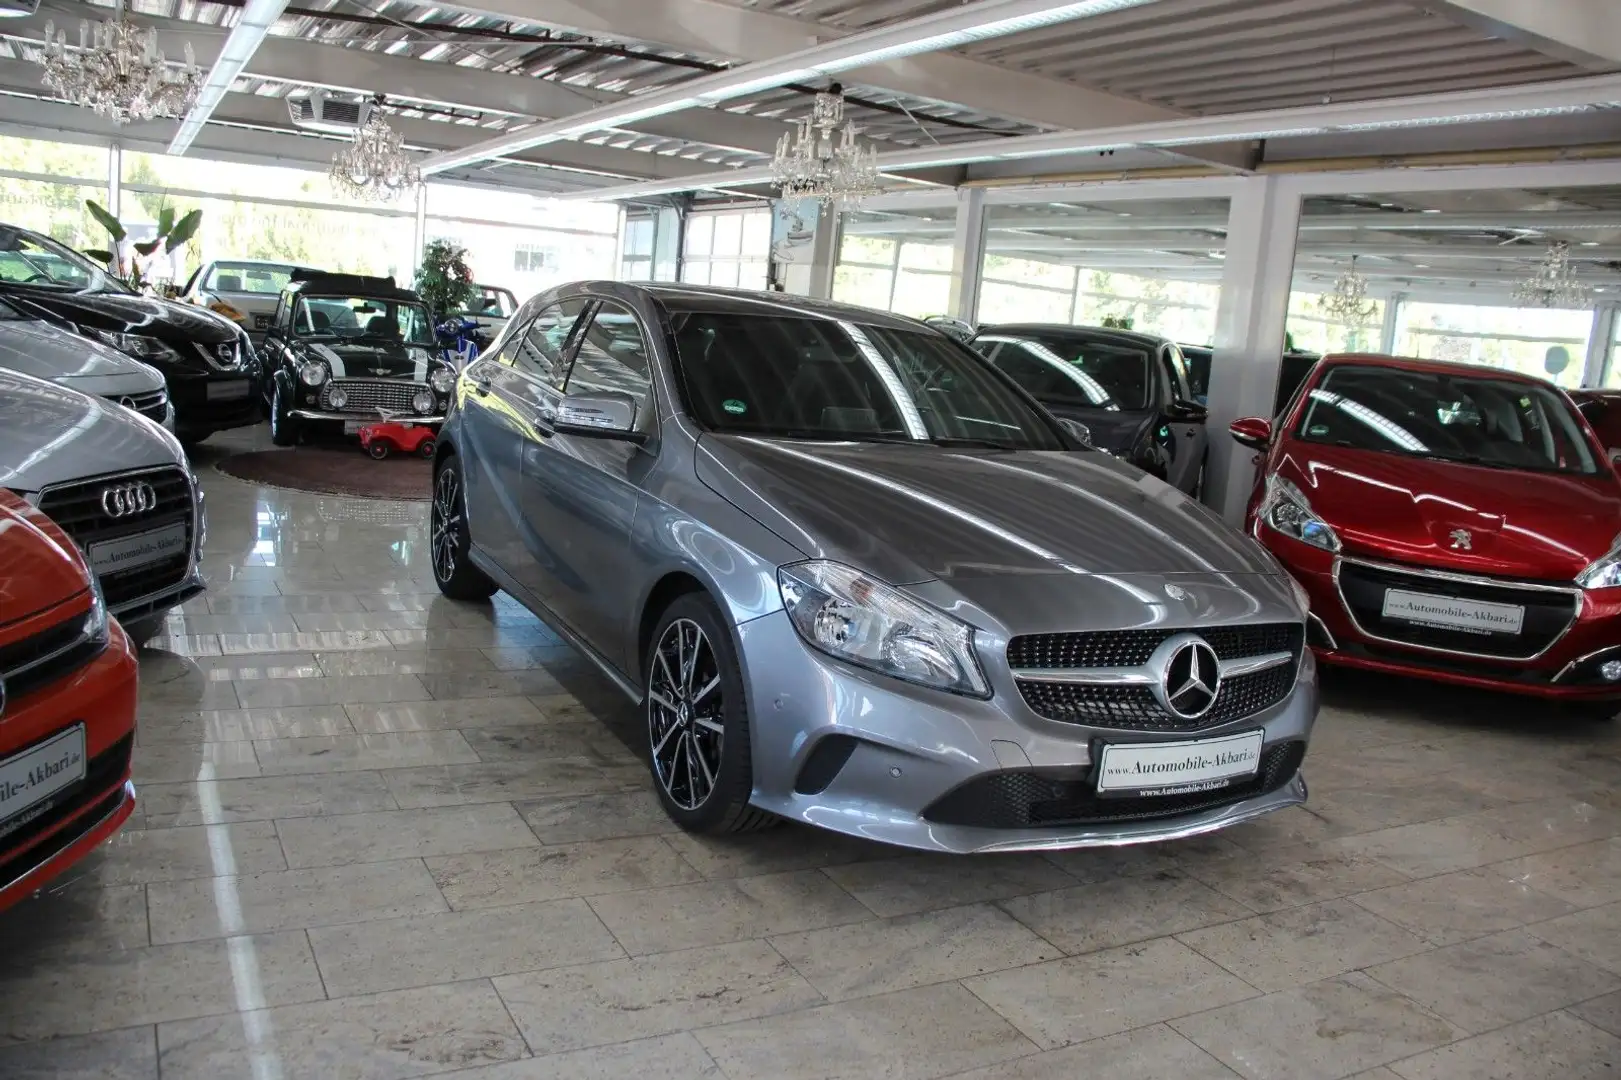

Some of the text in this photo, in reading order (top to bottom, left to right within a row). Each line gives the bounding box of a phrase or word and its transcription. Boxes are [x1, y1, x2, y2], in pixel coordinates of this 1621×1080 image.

[1388, 601, 1518, 625] www.Automobile-Akbari.de
[1409, 619, 1492, 636] www.Automobile-Akbari.de
[1107, 749, 1256, 775] www.Automobile-Akbari.de
[1140, 779, 1230, 797] www.Automobile-Akbari.de
